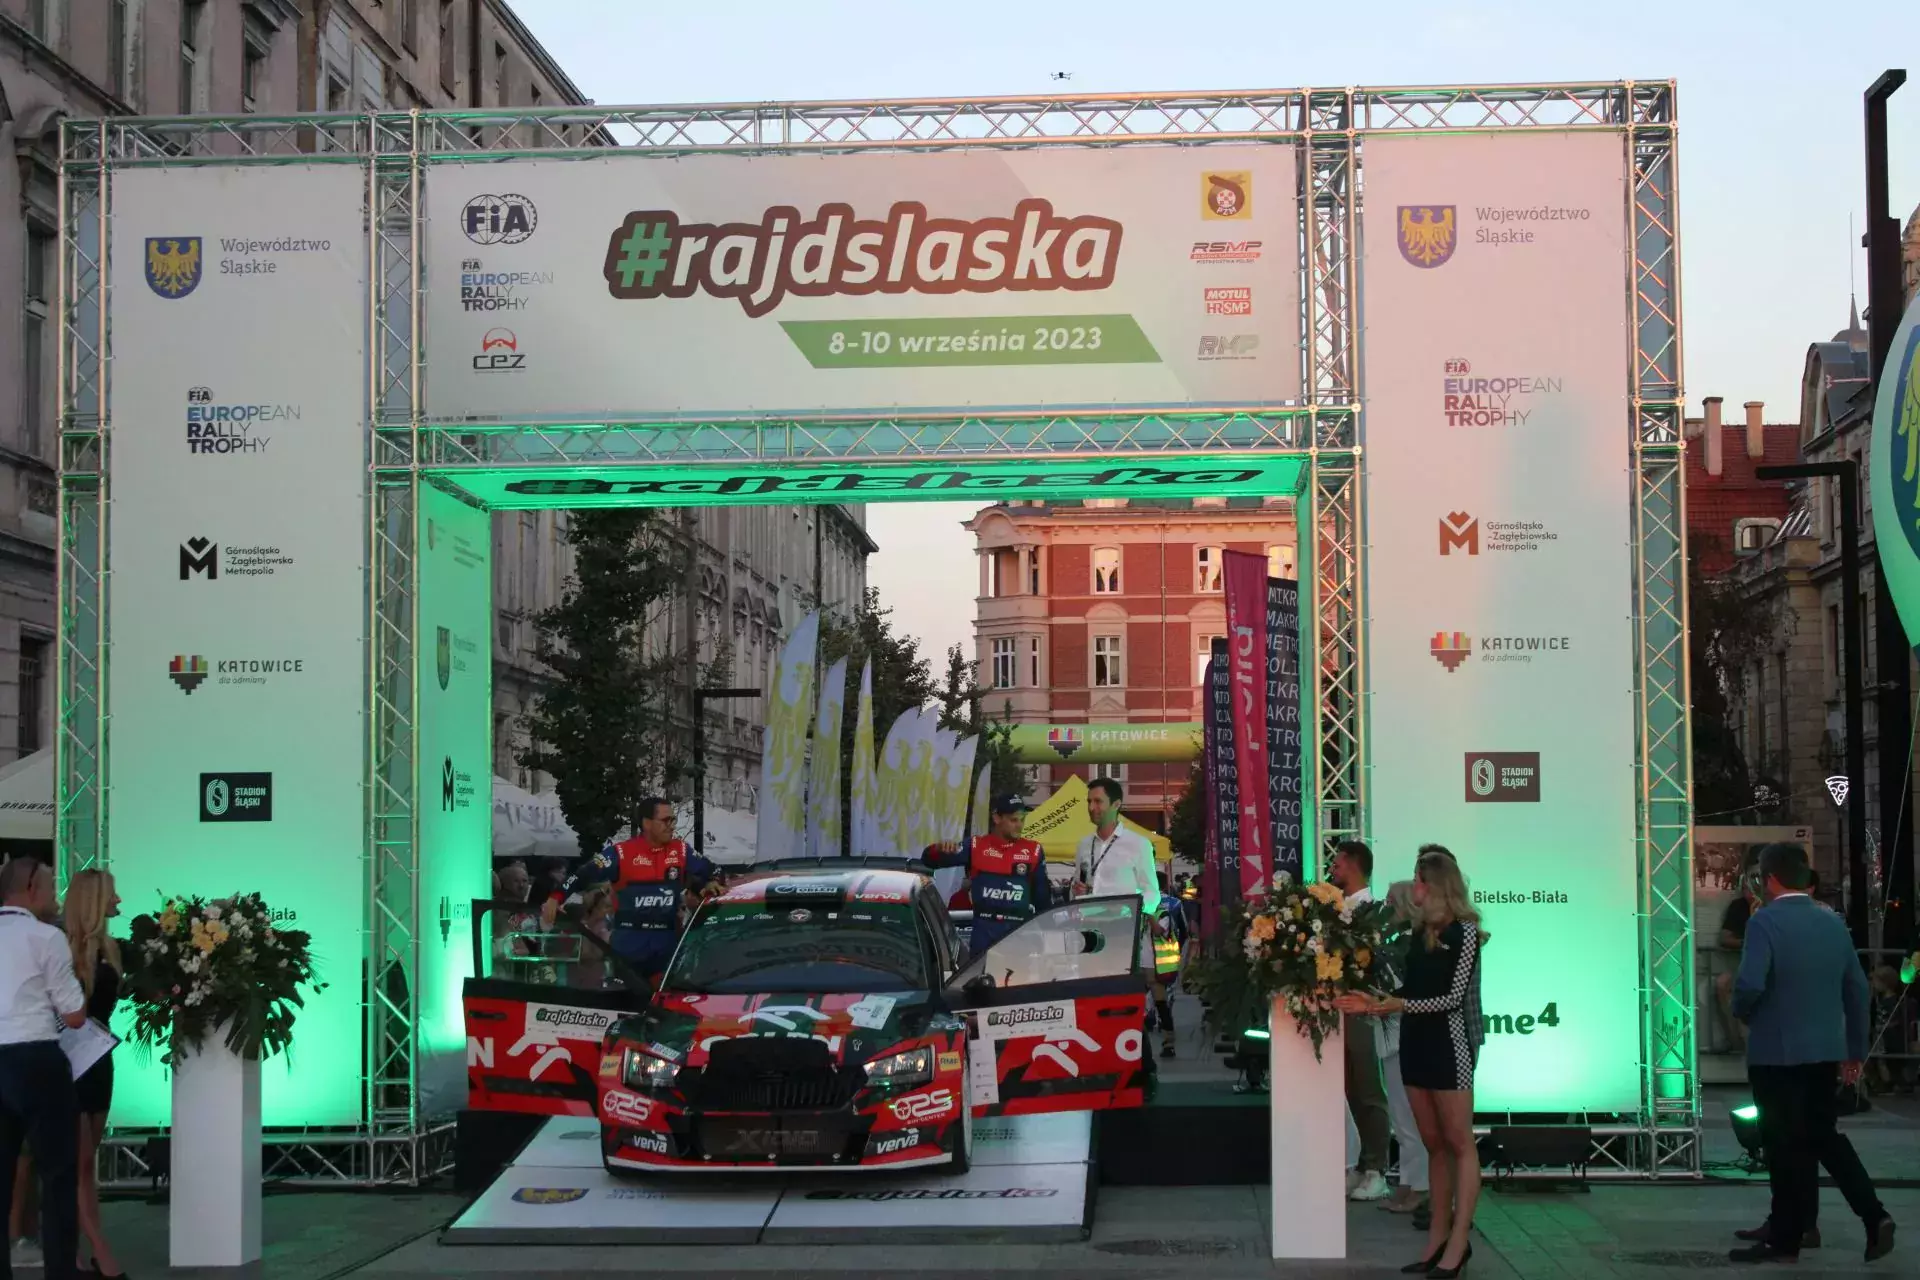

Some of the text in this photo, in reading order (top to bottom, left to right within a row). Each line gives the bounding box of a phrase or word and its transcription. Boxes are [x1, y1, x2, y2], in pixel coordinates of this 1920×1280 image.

[1475, 206, 1590, 224] Województwo
[1475, 226, 1534, 247] Śląskie
[220, 237, 331, 255] Województwo
[1192, 241, 1262, 252] RSMP
[610, 202, 1118, 312] #rajdslaska
[220, 257, 277, 277] Śląskie
[461, 271, 554, 286] EUROPEAN
[461, 286, 514, 298] RALLY
[1206, 289, 1250, 300] MOTUL
[461, 298, 529, 311] TROPHY
[828, 326, 1103, 355] 8-10 września 2023
[1444, 377, 1562, 393] EUROPEAN
[1444, 394, 1511, 410] RALLY
[187, 404, 301, 421] EUROPEAN
[1444, 409, 1531, 426] TROPHY
[187, 421, 252, 438] RALLY
[187, 437, 271, 454] TROPHY
[504, 468, 1263, 496] #rajdslaska
[1487, 543, 1538, 552] Metropolia
[225, 567, 274, 576] Metropolia
[1267, 587, 1299, 607] MIKR
[1481, 637, 1570, 650] KATOWICE
[218, 660, 303, 673] KATOWICE
[1091, 729, 1169, 742] KATOWICE
[1501, 767, 1534, 776] STADION
[234, 787, 266, 796] STADION
[1501, 777, 1528, 789] ŚLĄSKI
[1024, 814, 1070, 839] OTOROWY
[634, 894, 675, 908] verva
[1473, 890, 1568, 904] Bielsko-Biała
[535, 1007, 609, 1027] #rajdslaska
[987, 1006, 1064, 1026] #rajdslaska
[1482, 1001, 1560, 1035] me4
[633, 1135, 668, 1153] verva
[876, 1133, 919, 1154] verva
